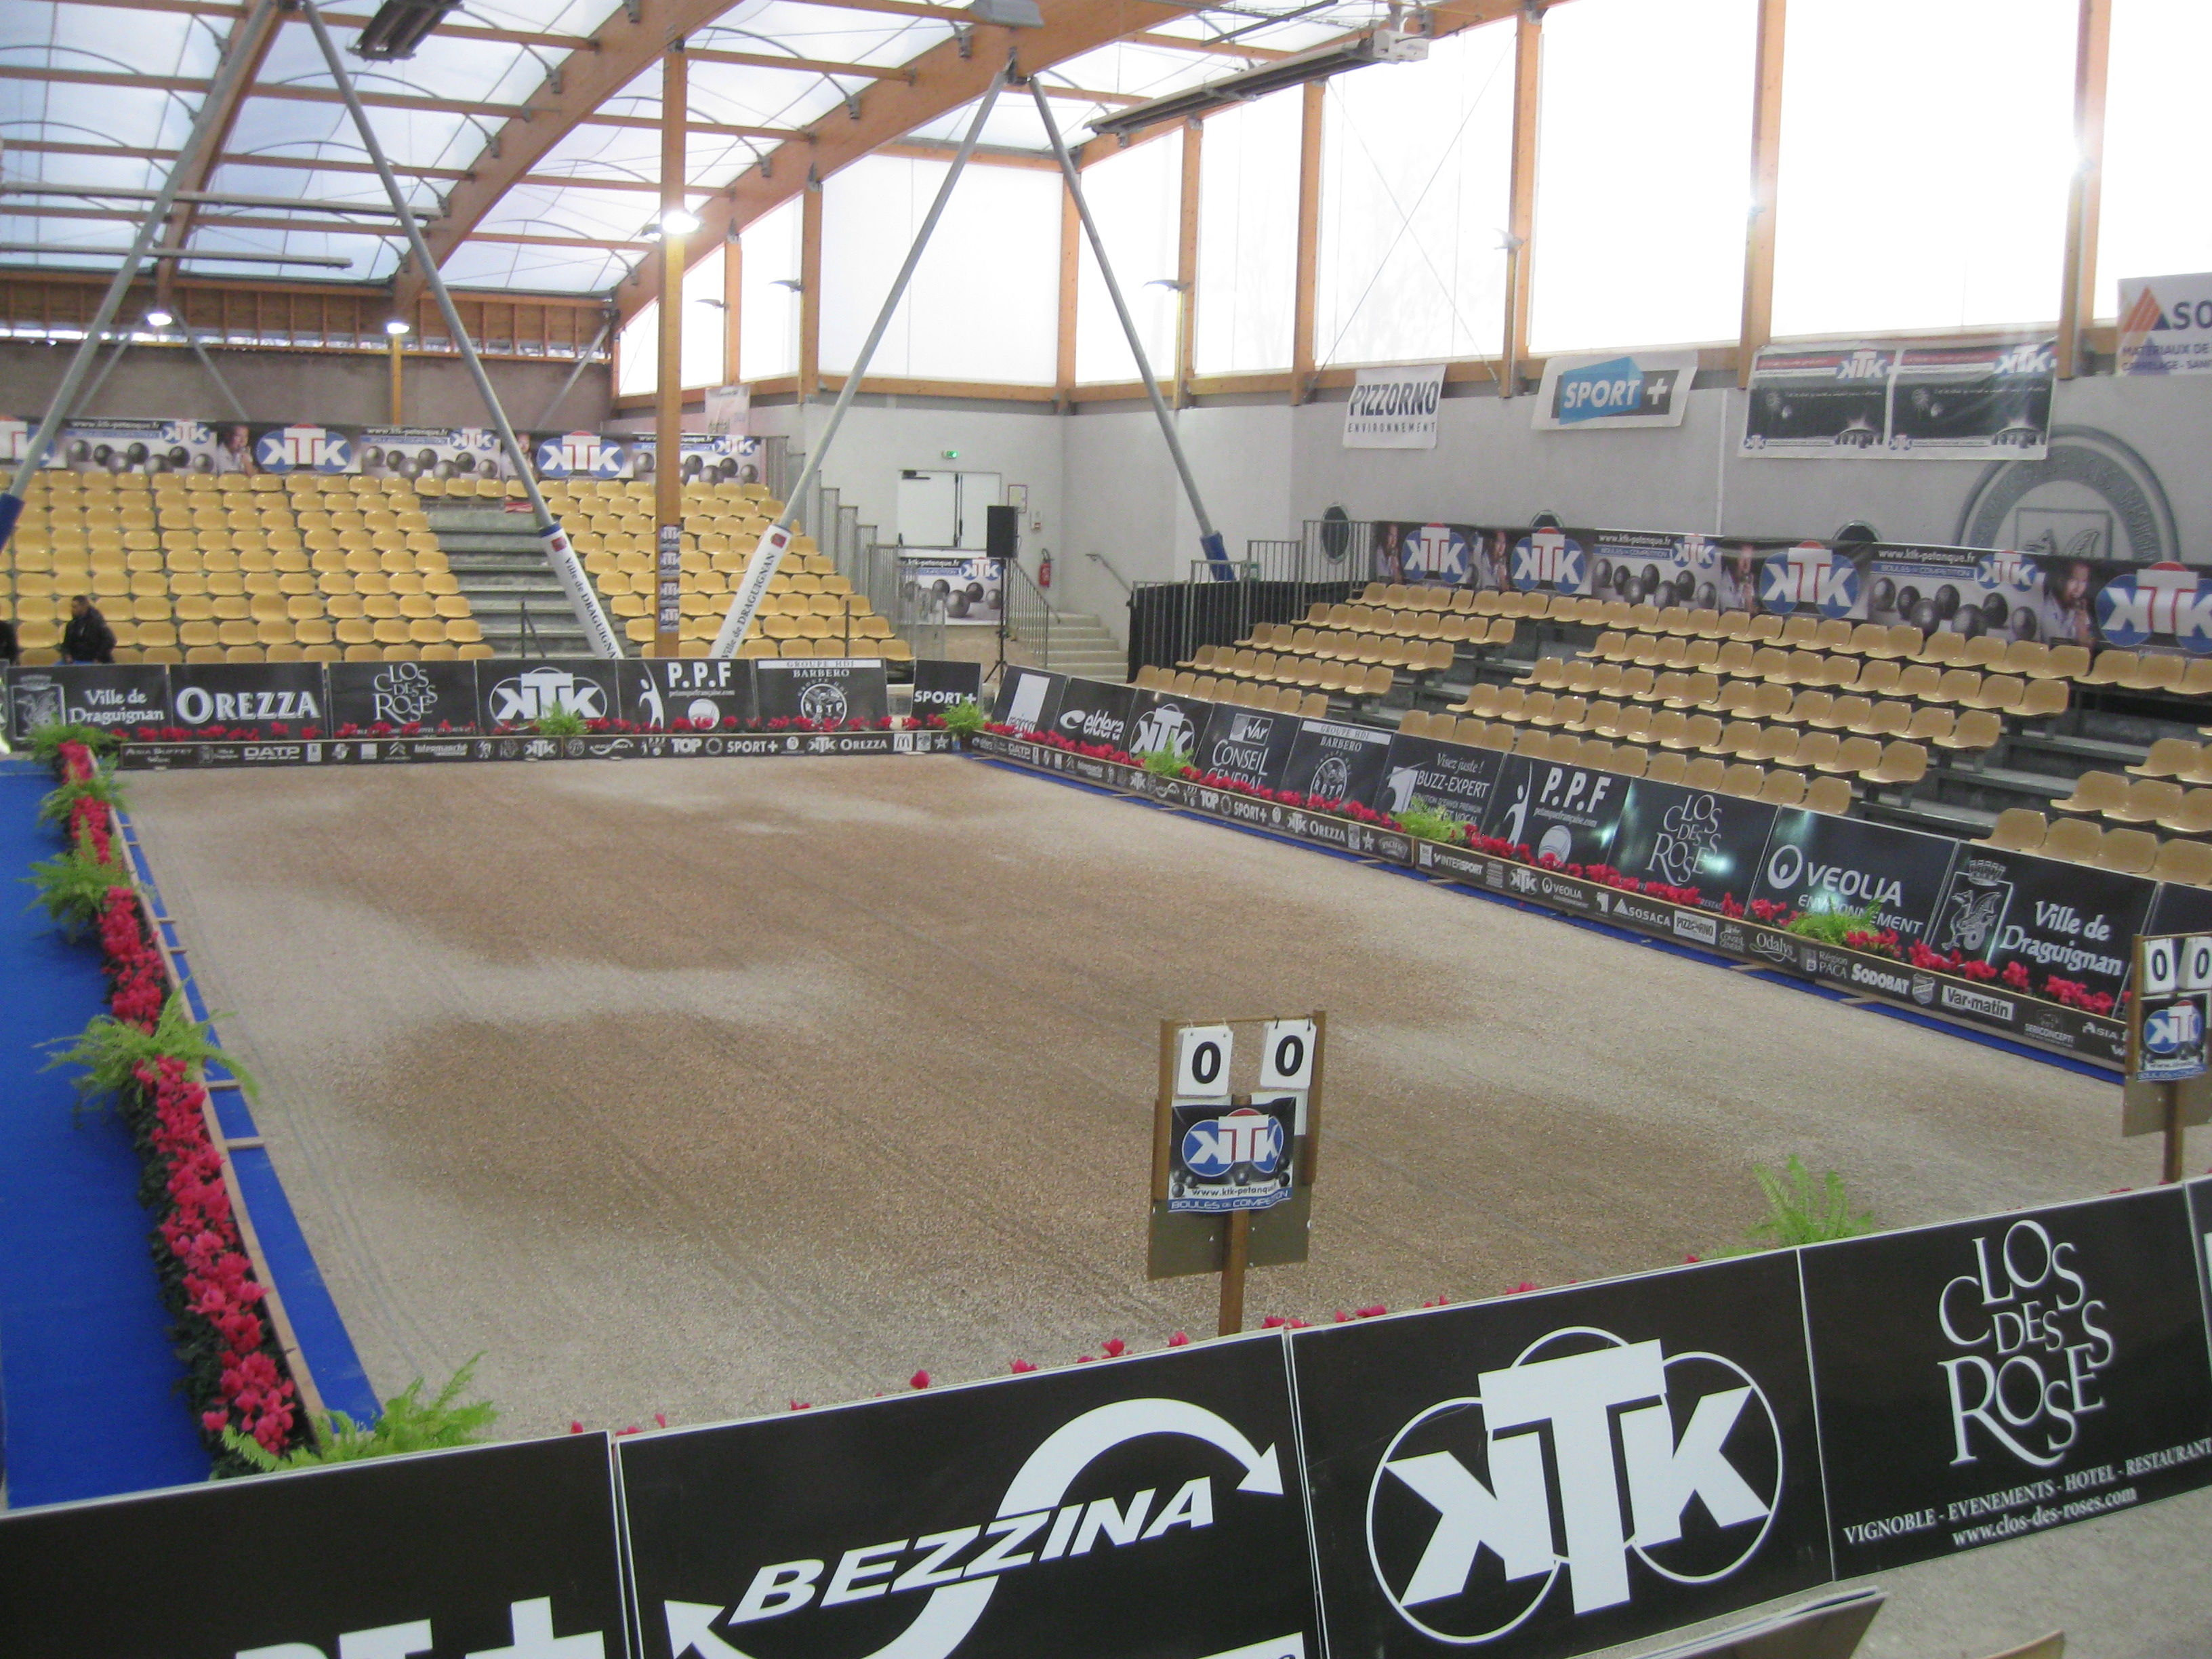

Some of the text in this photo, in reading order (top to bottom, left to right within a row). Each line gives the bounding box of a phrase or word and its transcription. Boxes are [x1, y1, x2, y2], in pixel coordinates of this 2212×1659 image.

[1836, 351, 1886, 379] KTK
[1349, 381, 1439, 416] PIZZORNO
[1563, 380, 1641, 409] SPORT
[162, 419, 209, 442] KTK
[452, 428, 495, 449] KTK
[1348, 422, 1436, 433] ENVIRONNEMENT
[262, 428, 349, 466] KTK
[541, 435, 621, 472] KTK
[1404, 527, 1465, 575] KTK
[1511, 533, 1583, 583] KTK
[1673, 535, 1715, 565] KTK
[565, 557, 577, 579] Ville
[963, 558, 999, 578] KTK
[1763, 548, 1854, 607] KTK
[1878, 548, 2036, 587] www.ktk-petanque.fr KTK
[737, 552, 776, 626] DRAGUIGNAN
[374, 662, 429, 692] CLOS
[787, 660, 829, 668] GROUPE
[793, 669, 850, 678] BARBERO
[85, 688, 148, 705] Ville de
[176, 686, 322, 724] OREZZA
[394, 682, 419, 697] DES
[495, 672, 602, 720] KTK
[914, 690, 962, 703] SPORT
[69, 706, 165, 726] Draguignan
[1084, 710, 1125, 741] eldera
[1131, 708, 1192, 758] KTK
[244, 746, 300, 760] DATP
[670, 737, 703, 754] TOP
[840, 739, 887, 751] OREZZA
[1212, 738, 1269, 776] CONSEIL
[1319, 736, 1363, 753] BARBERO
[1437, 752, 1458, 770] Visez
[1454, 758, 1479, 774] juste
[1416, 770, 1491, 799] BUZZ-EXPERT
[1200, 790, 1219, 810] TOP
[1309, 819, 1346, 843] OREZZA
[1663, 794, 1723, 834] CLOS
[1677, 823, 1704, 846] DES
[1553, 884, 1583, 900] VEOLIA
[1807, 862, 1902, 907] VEOLIA
[1627, 906, 1671, 928] SOSACA
[2035, 900, 2112, 942] Ville de
[1757, 932, 1794, 958] Odalys
[1999, 924, 2125, 977] Draguignan
[1819, 960, 1847, 979] PACA
[1851, 962, 1910, 995] SODOBAT
[2151, 947, 2209, 981] 0 0
[1191, 1034, 1304, 1084] 0 0
[1189, 1114, 1279, 1165] KTK
[1170, 1200, 1221, 1210] BOULES
[1939, 1219, 2085, 1346] CLOS
[1992, 1300, 2064, 1354] DES
[1936, 1300, 2114, 1468] ROSES
[1385, 1338, 1771, 1616] KTK
[1843, 1507, 1938, 1545] VIGNOBLE
[1948, 1479, 2056, 1522] EVENEMENTS
[2065, 1463, 2116, 1492] HOTEL
[1952, 1487, 2139, 1547] www.clos-des-roses.com
[729, 1475, 1214, 1626] BEZZINA
